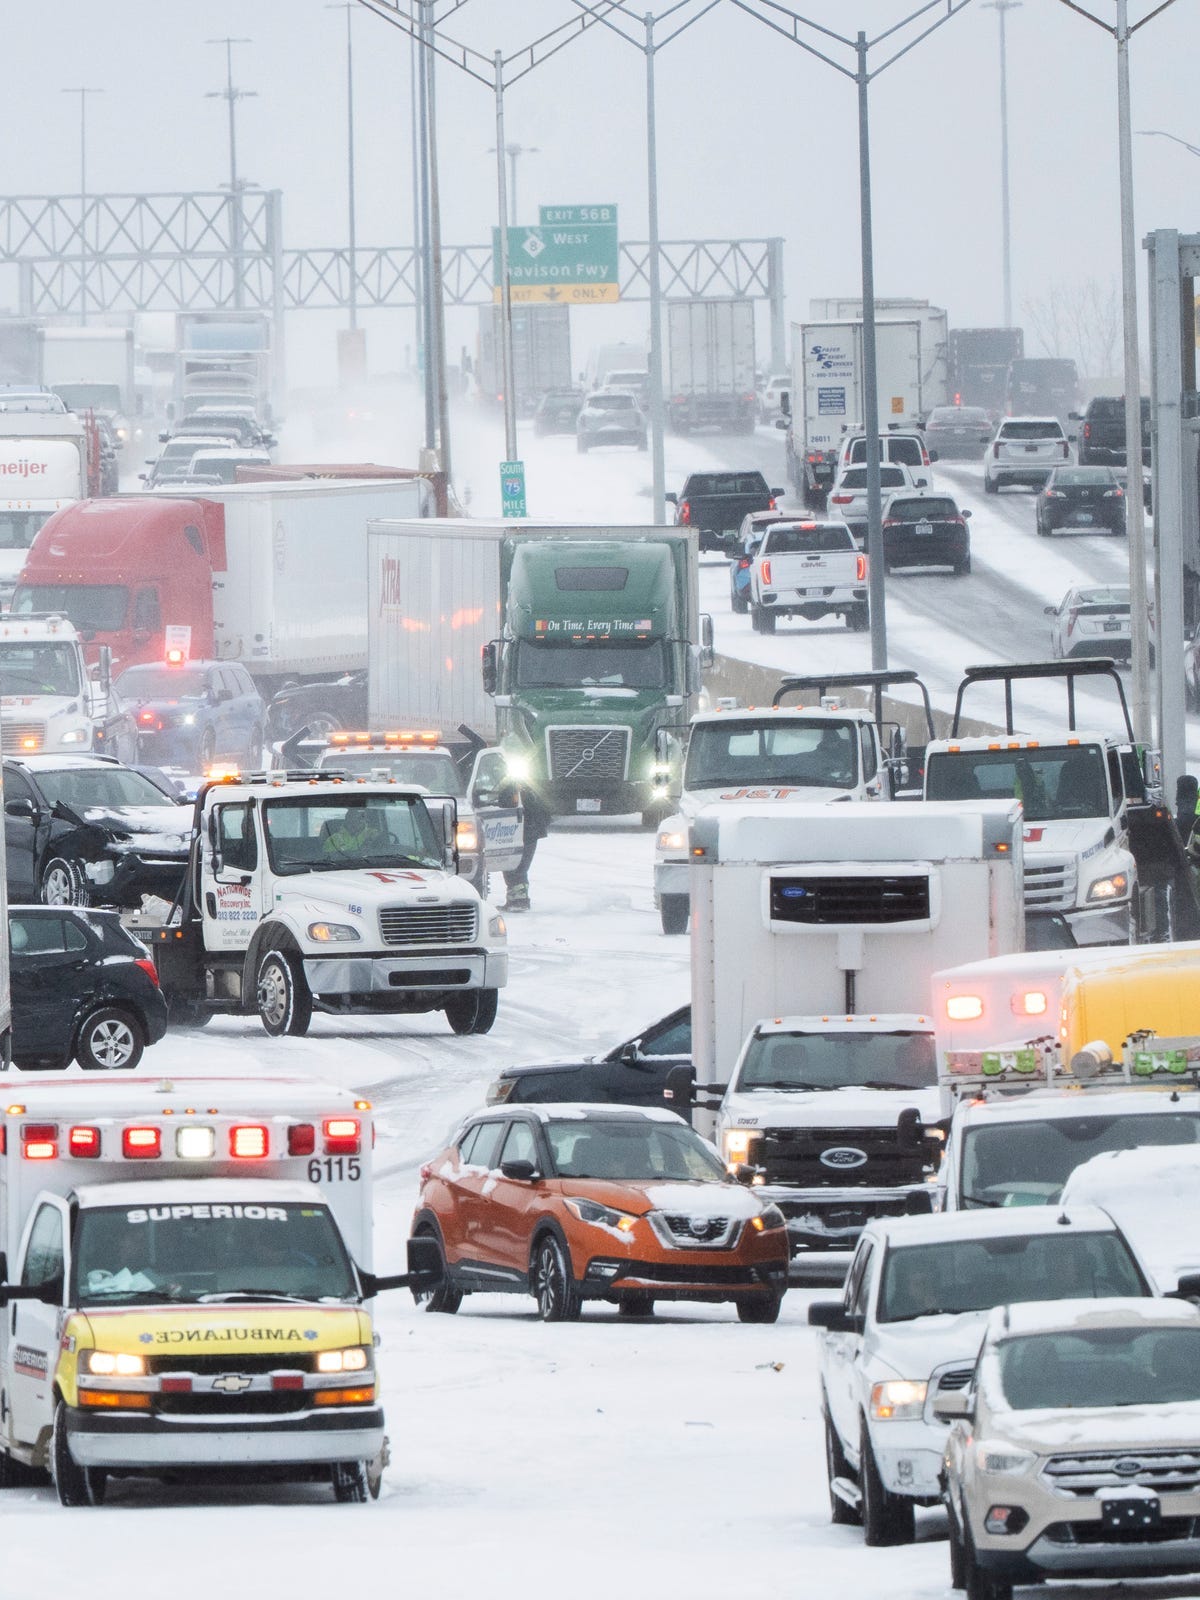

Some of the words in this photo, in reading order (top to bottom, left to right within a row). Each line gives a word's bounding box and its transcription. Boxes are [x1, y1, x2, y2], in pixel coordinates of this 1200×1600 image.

[546, 211, 574, 220] EXIT
[580, 208, 610, 220] 56B
[553, 233, 589, 244] WEST
[529, 241, 538, 252] 8
[509, 264, 570, 277] avison
[576, 264, 608, 278] Fwy
[513, 290, 531, 300] XIT
[572, 288, 607, 299] ONLY
[500, 464, 524, 474] SOUTH
[506, 482, 521, 495] 75
[504, 501, 525, 510] MILE
[548, 620, 560, 630] On
[563, 620, 585, 631] Time,
[588, 620, 612, 634] Every
[614, 620, 634, 630] Time
[719, 788, 800, 801] J&T
[364, 871, 427, 883] N
[216, 884, 252, 898] NATIONWIDE
[348, 904, 362, 914] 166
[832, 1151, 856, 1162] Ford
[307, 1157, 362, 1183] 6115
[126, 1205, 288, 1224] SUPERIOR
[14, 1350, 48, 1373] SUPERIOR
